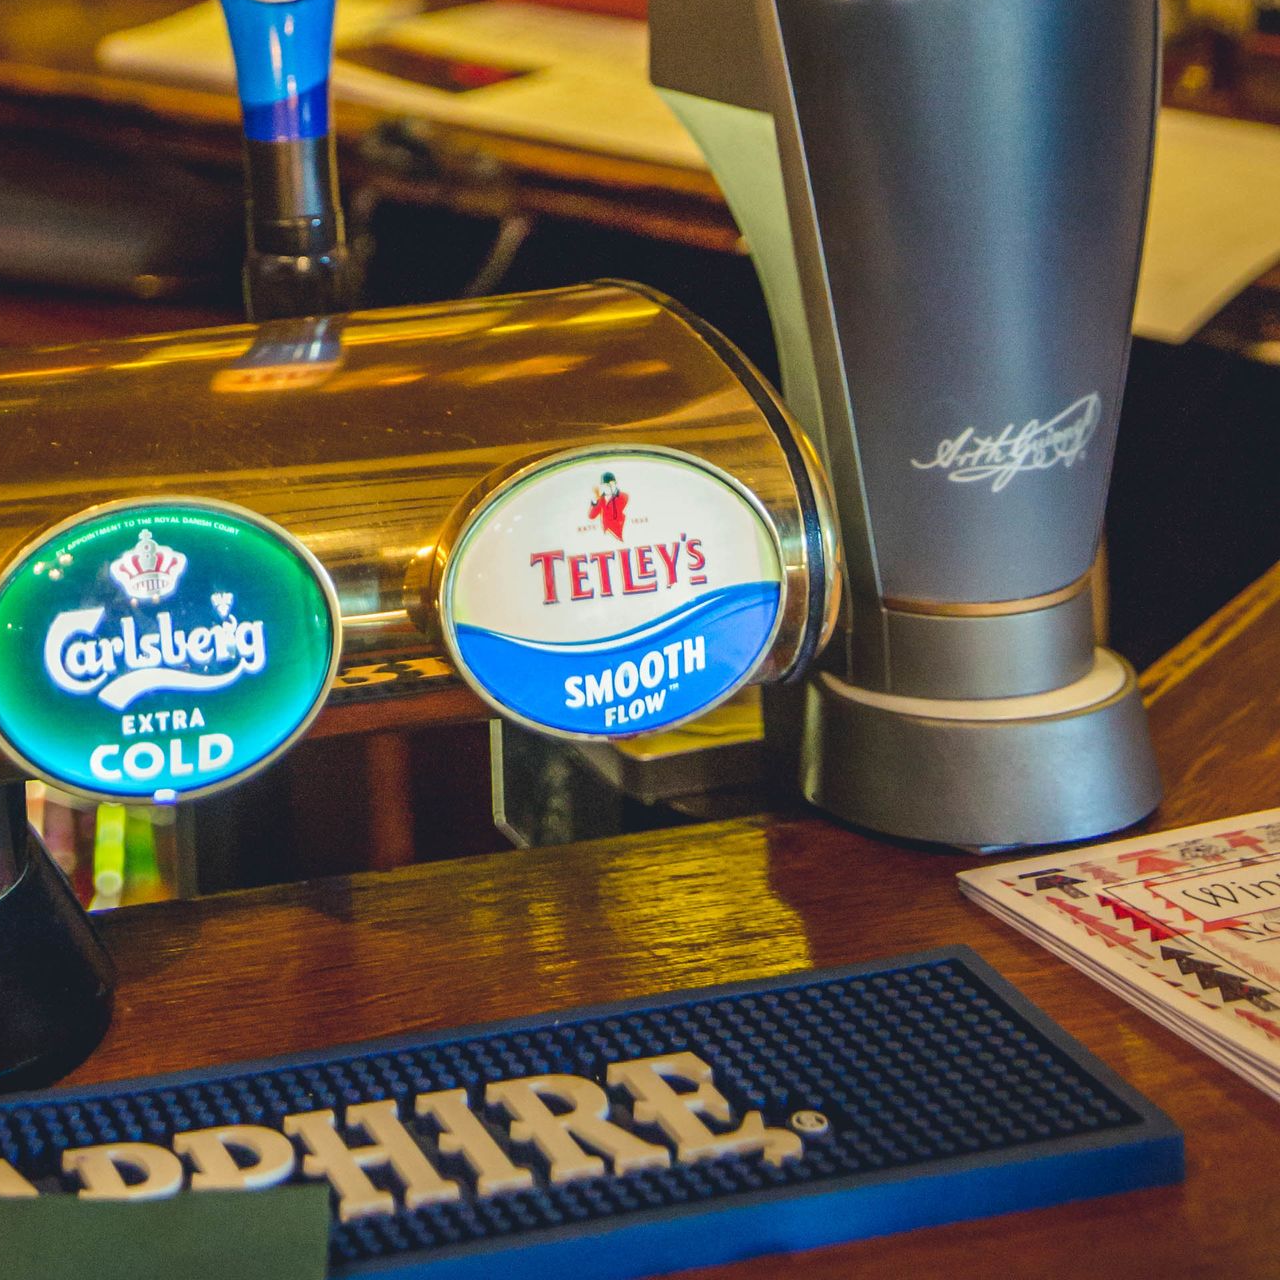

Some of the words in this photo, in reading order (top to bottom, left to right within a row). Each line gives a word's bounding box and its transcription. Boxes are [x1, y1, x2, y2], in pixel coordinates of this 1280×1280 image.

[67, 523, 122, 550] APPOINTMENT
[123, 520, 135, 528] TO
[136, 517, 153, 525] THE
[154, 516, 180, 524] ROYAL
[182, 516, 212, 528] DANISH
[213, 521, 240, 536] COURT
[530, 532, 708, 605] TETLEY'S
[44, 603, 266, 706] Carlsberg
[564, 635, 706, 710] SMOOTH
[121, 707, 206, 736] EXTRA
[604, 690, 668, 728] FLOW
[89, 733, 235, 782] COLD
[1182, 875, 1280, 908] Win
